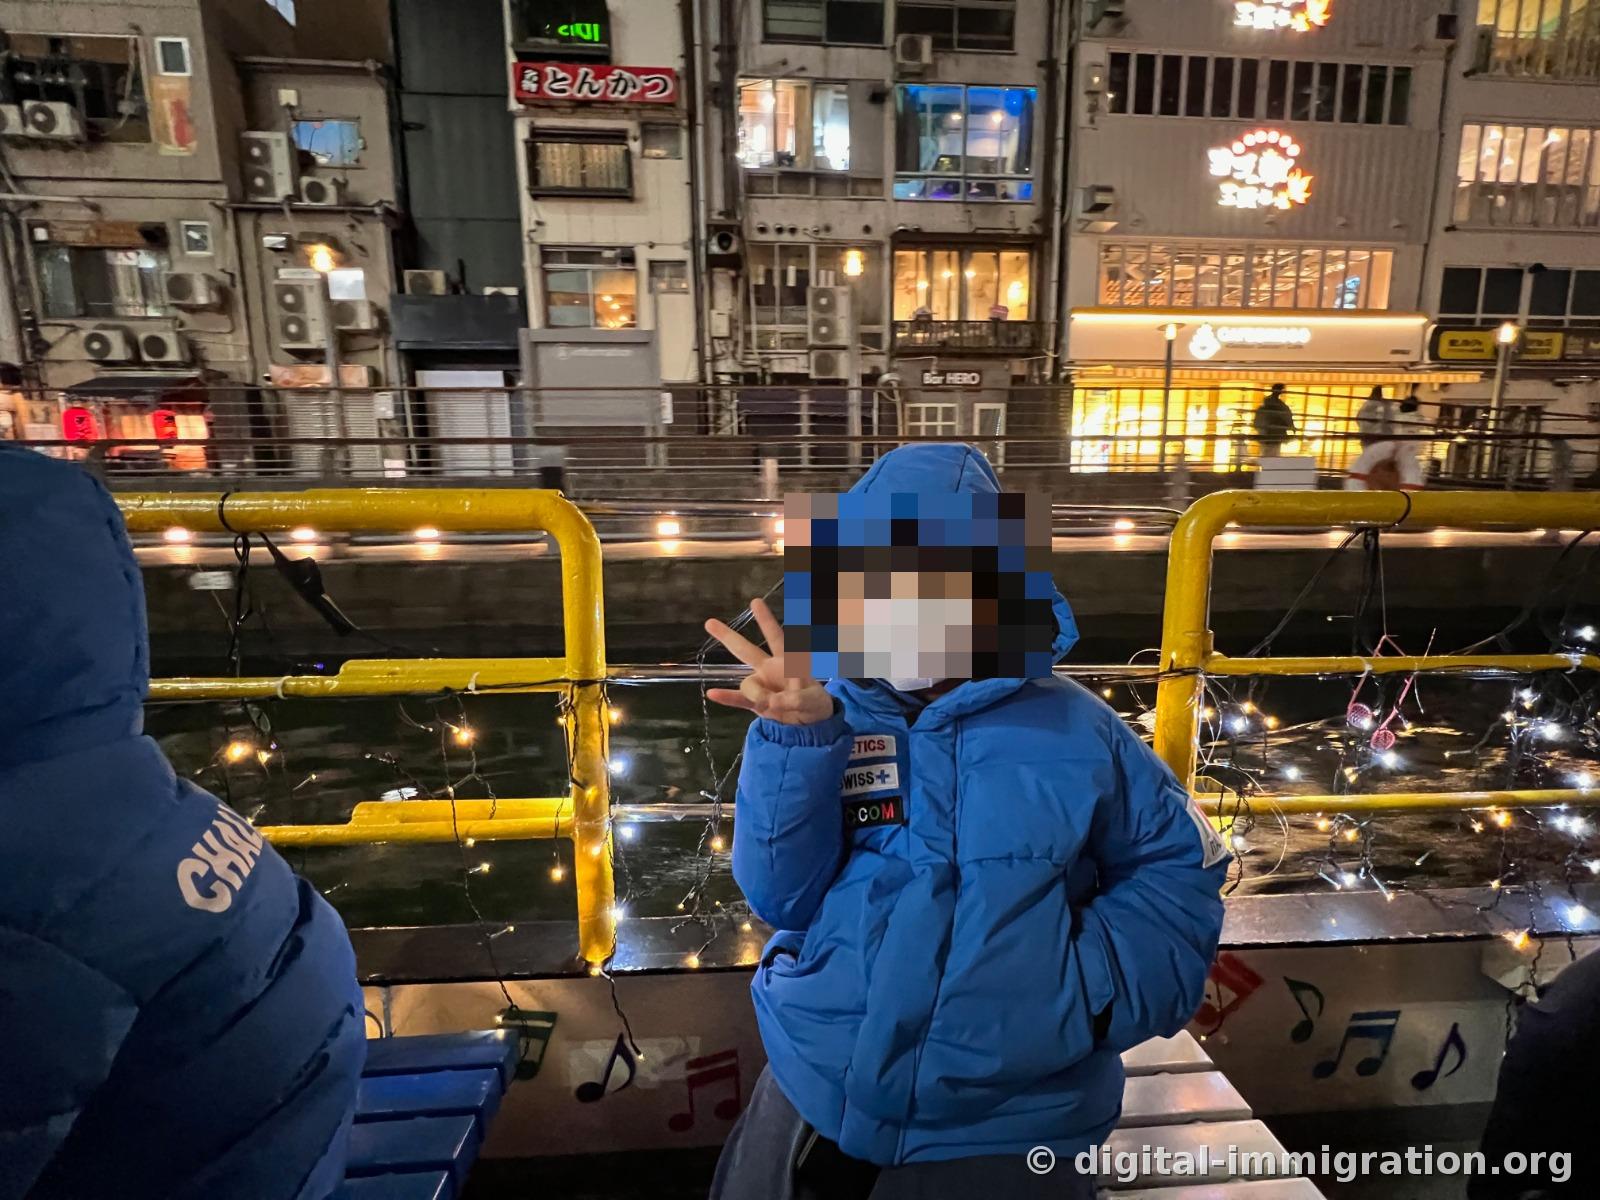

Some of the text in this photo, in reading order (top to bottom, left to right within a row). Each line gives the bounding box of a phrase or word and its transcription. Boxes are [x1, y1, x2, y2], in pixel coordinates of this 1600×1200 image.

[544, 66, 672, 98] とんかつ
[946, 372, 980, 385] HERO
[840, 771, 875, 789] WISS
